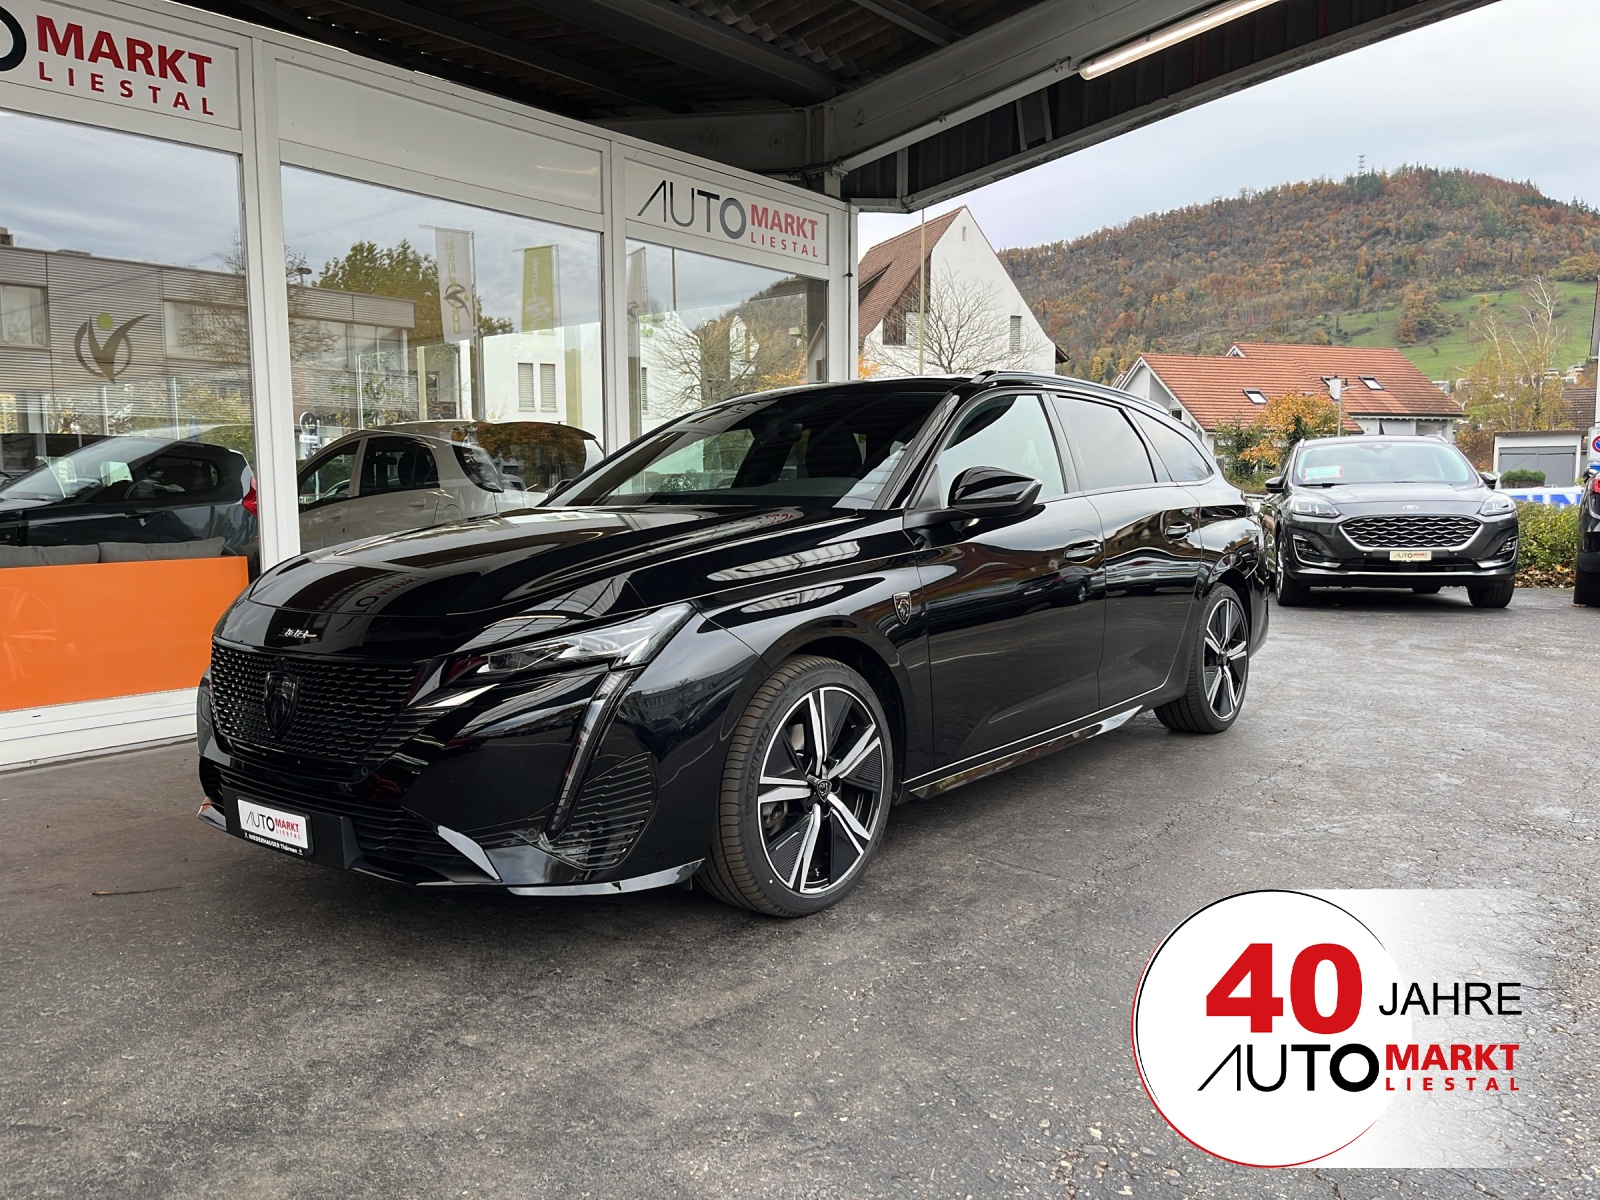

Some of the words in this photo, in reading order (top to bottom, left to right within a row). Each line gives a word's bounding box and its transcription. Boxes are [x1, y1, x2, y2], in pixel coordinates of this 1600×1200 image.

[36, 14, 212, 88] MARKT
[38, 61, 214, 116] LIESTAL
[750, 203, 818, 241] MARKT
[750, 231, 818, 258] LIESTAL
[276, 828, 300, 840] LIESTAL
